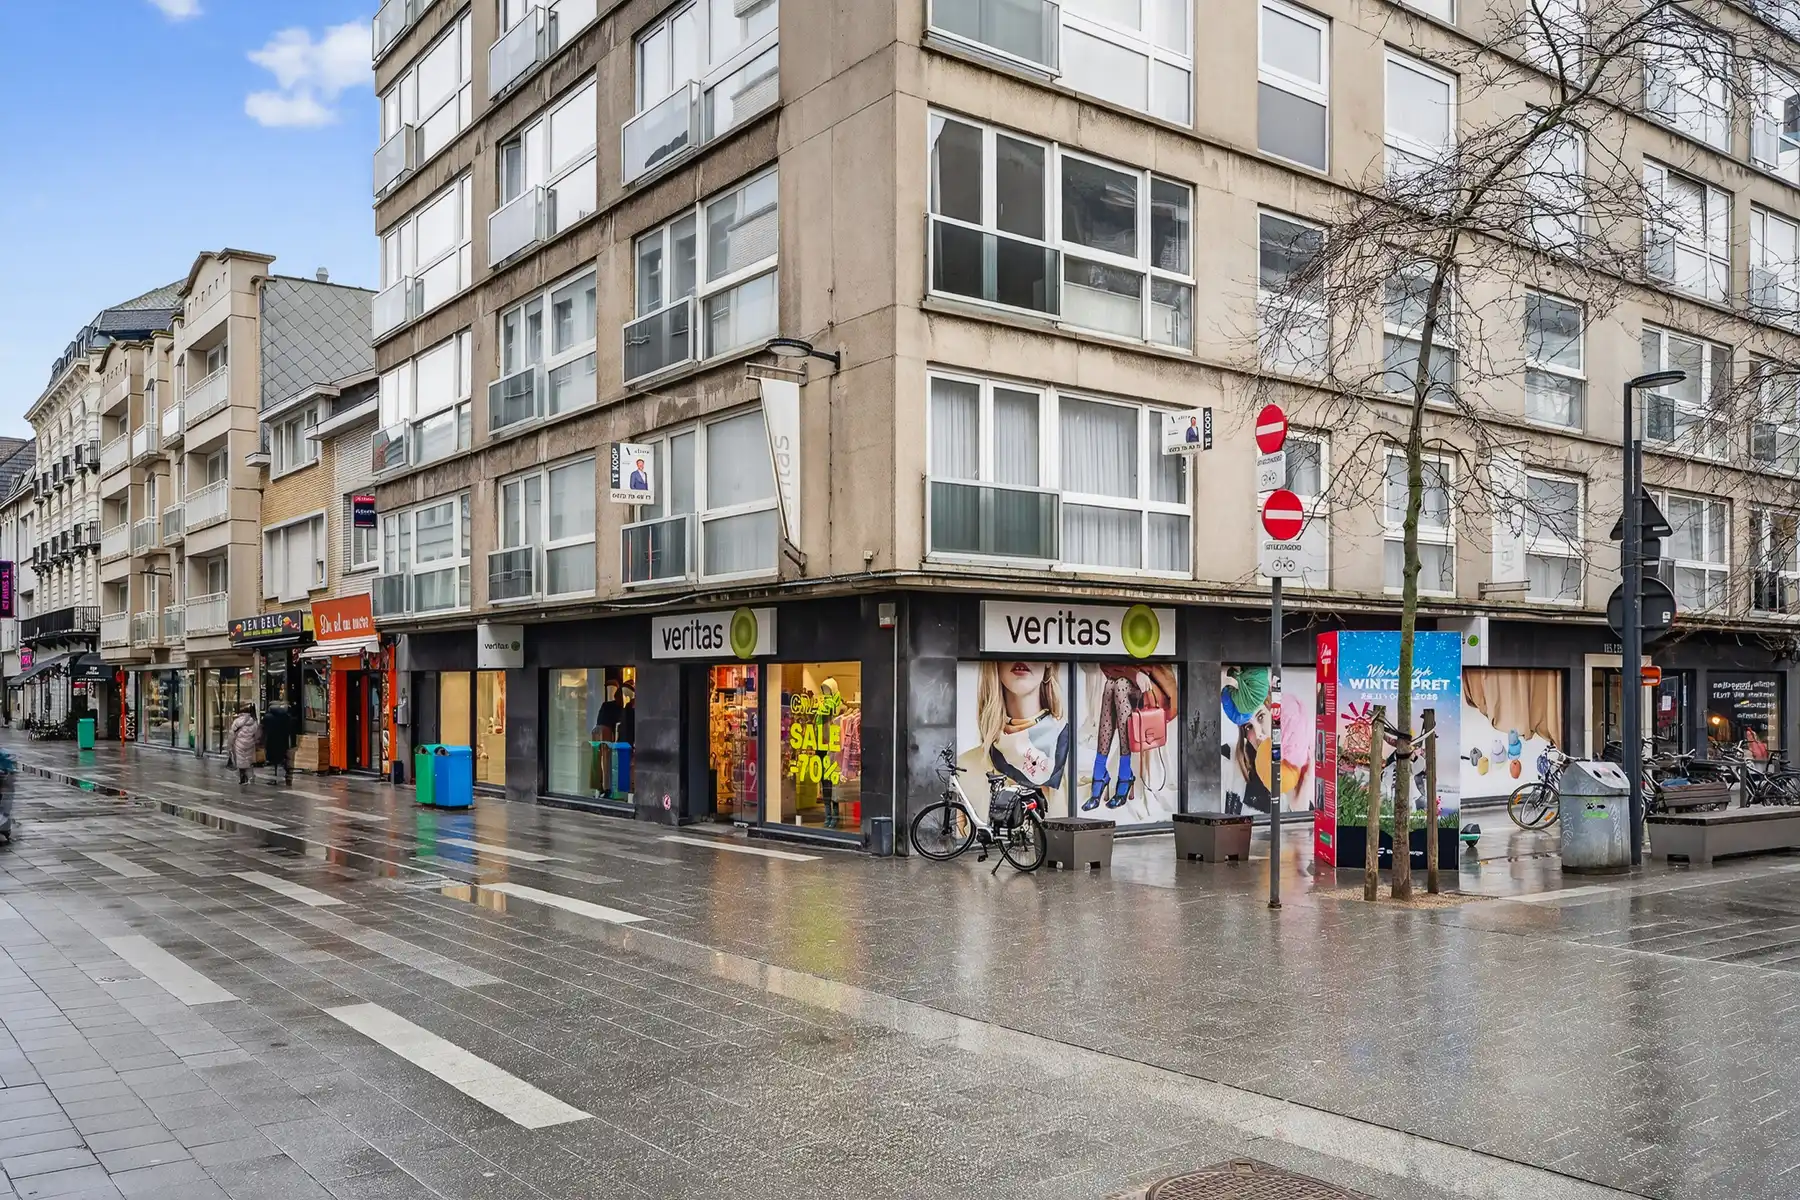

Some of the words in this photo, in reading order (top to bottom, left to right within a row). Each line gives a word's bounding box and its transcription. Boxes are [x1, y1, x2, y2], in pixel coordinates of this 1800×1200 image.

[611, 447, 619, 471] KOOP
[661, 619, 723, 651] veritas
[1006, 610, 1111, 646] veritas
[484, 642, 510, 650] veritas
[1349, 678, 1450, 691] WINTEPRET
[790, 722, 841, 752] SALE
[789, 753, 840, 785] -70%
